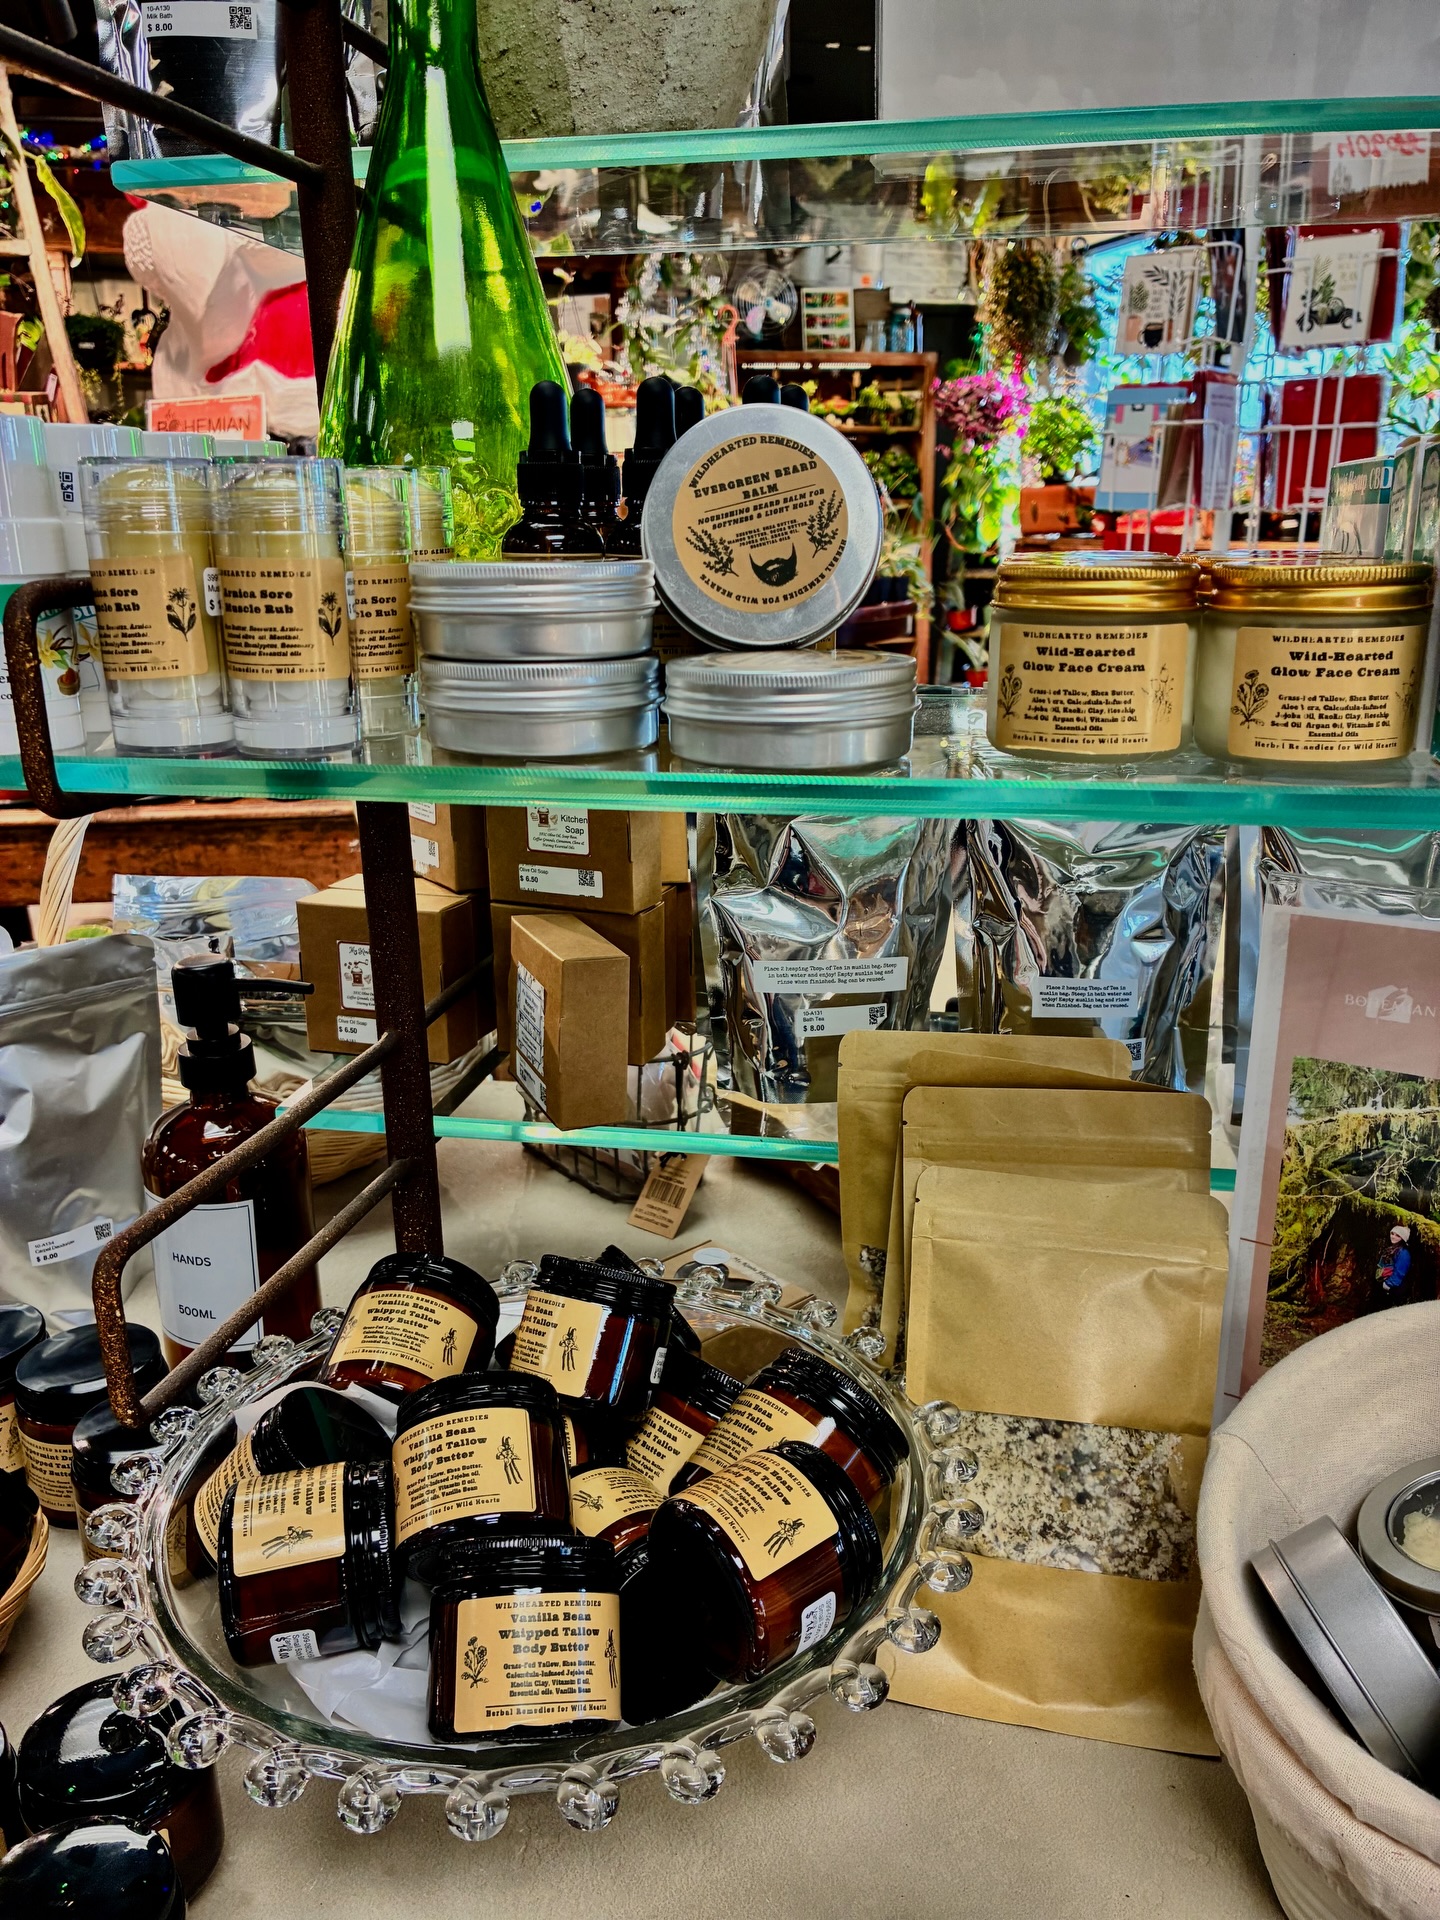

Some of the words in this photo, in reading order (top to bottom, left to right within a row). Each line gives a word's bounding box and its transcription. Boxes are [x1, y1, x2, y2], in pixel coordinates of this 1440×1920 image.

[147, 24, 153, 32] $
[155, 23, 173, 31] 8.00
[157, 412, 250, 433] BOHEMIAN
[688, 436, 758, 490] WILDHEARTED
[759, 435, 817, 460] REMEDIES
[693, 470, 771, 499] EVERGREEN
[774, 460, 818, 478] BEARD
[742, 483, 780, 500] BALM
[697, 506, 751, 525] NOURISHING
[752, 500, 781, 513] BEARD
[782, 494, 807, 505] BALM
[808, 488, 826, 500] FOR
[712, 514, 755, 531] SOFTNESS
[756, 512, 763, 520] &
[764, 506, 792, 519] LIGHT
[792, 500, 815, 512] HOLD
[826, 539, 847, 574] HERBAL
[699, 573, 734, 597] HEARTS
[782, 574, 826, 602] REMEDIES
[110, 588, 139, 598] Sore
[224, 588, 257, 599] Arnica
[260, 589, 293, 599] Sore
[735, 593, 759, 605] WILD
[114, 602, 140, 612] Rub
[371, 596, 397, 605] Sore
[762, 596, 780, 605] FOR
[225, 603, 261, 614] Muscle
[264, 604, 294, 614] Rub
[375, 608, 398, 617] Rub
[1023, 631, 1092, 640] WILDHEARTED
[1096, 631, 1148, 640] REMEDIES
[1272, 635, 1353, 643] WILDHEARTED
[1357, 634, 1405, 643] REMEDIES
[1036, 646, 1136, 658] Wild-Hearted
[1289, 650, 1394, 662] Wild-Hearted
[1023, 661, 1055, 673] Glow
[1058, 662, 1093, 673] Face
[1097, 662, 1145, 673] Cream
[1271, 666, 1311, 677] Glow
[1315, 667, 1353, 678] Face
[1357, 666, 1401, 677] Cream
[560, 814, 588, 824] Kitchen
[565, 825, 585, 836] Soap
[519, 866, 530, 874] Olive
[537, 868, 549, 876] Soap
[525, 875, 539, 883] 6.50
[785, 965, 809, 974] heaping
[809, 965, 825, 973] Tbsp.
[825, 964, 833, 972] of
[852, 963, 871, 971] muslin
[871, 963, 883, 971] bag.
[883, 962, 897, 970] Steep
[819, 971, 837, 980] enjoy!
[837, 971, 854, 979] Empty
[874, 969, 884, 977] bag
[837, 978, 848, 986] Bag
[344, 1026, 358, 1034] 6.50
[810, 1024, 825, 1032] 8.00
[35, 1246, 51, 1254] Carpet
[43, 1252, 58, 1261] 8.00
[172, 1252, 212, 1267] HANDS
[377, 1299, 410, 1308] Vanilla
[411, 1302, 436, 1315] Bean
[415, 1296, 449, 1311] REMEDIES
[178, 1304, 217, 1320] 500ML
[367, 1308, 407, 1317] Whipped
[409, 1310, 441, 1326] Tallow
[535, 1305, 553, 1317] Bean
[371, 1315, 395, 1325] Body
[396, 1317, 429, 1330] Butter
[532, 1316, 558, 1330] Tallow
[524, 1326, 547, 1338] Butter
[752, 1402, 773, 1419] Bean
[446, 1414, 489, 1426] REMEDIES
[746, 1411, 774, 1434] Tallow
[657, 1425, 678, 1443] Bean
[733, 1419, 758, 1437] Butter
[408, 1432, 443, 1452] Vanilla
[445, 1425, 476, 1438] Bean
[403, 1446, 443, 1468] Whipped
[445, 1436, 487, 1451] Tallow
[641, 1439, 667, 1461] Butter
[653, 1434, 681, 1457] Tallow
[410, 1460, 434, 1477] Body
[436, 1450, 475, 1465] Butter
[770, 1468, 794, 1492] Bean
[743, 1475, 773, 1502] Butter
[761, 1474, 791, 1506] Tallow
[495, 1600, 561, 1610] WILDHEARTED
[564, 1599, 602, 1608] REMEDIES
[510, 1612, 560, 1623] Vanilla
[562, 1611, 592, 1622] Bean
[498, 1627, 559, 1641] Whipped
[562, 1627, 600, 1637] Tallow
[513, 1643, 547, 1656] Body
[550, 1642, 590, 1653] Butter
[485, 1708, 513, 1718] Herbal
[516, 1706, 555, 1716] Remedies
[557, 1705, 569, 1714] for
[571, 1704, 587, 1713] Wild
[588, 1703, 607, 1712] Hearts
